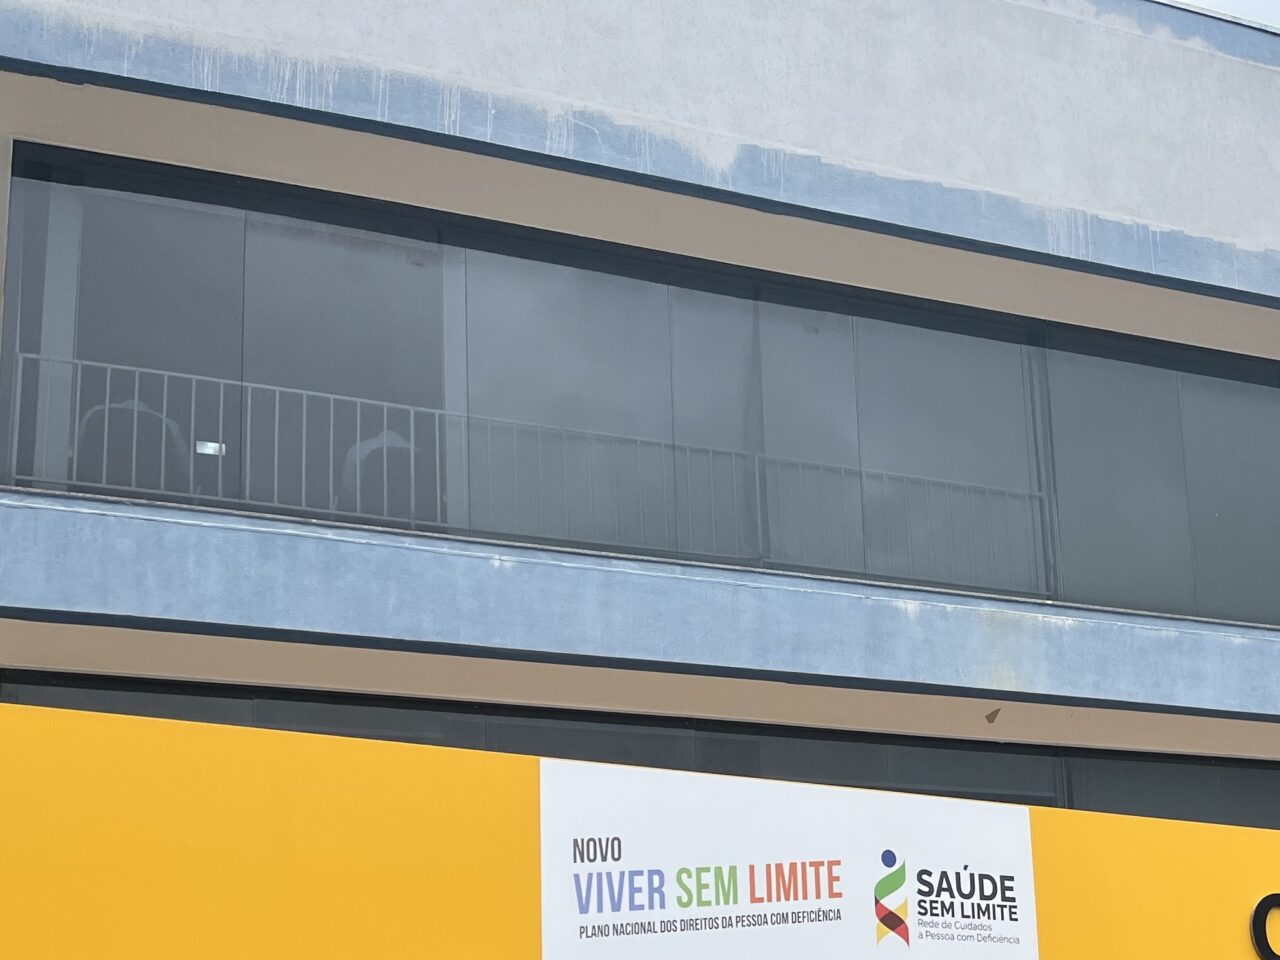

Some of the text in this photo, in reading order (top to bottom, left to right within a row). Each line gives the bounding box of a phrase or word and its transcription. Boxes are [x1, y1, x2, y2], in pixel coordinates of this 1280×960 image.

[573, 837, 622, 863] NOVO
[573, 860, 843, 915] VIVER SEM LIMITE
[916, 865, 1017, 903] SAÚDE
[580, 908, 842, 939] PLANO NACIONAL DOS DIREITOS DA PESSOA COM DEFICIÊNCIA
[917, 899, 1019, 922] SEM LIMITE
[917, 919, 993, 932] Rede de Cuidados
[925, 931, 955, 941] Pessoa
[956, 934, 975, 942] com
